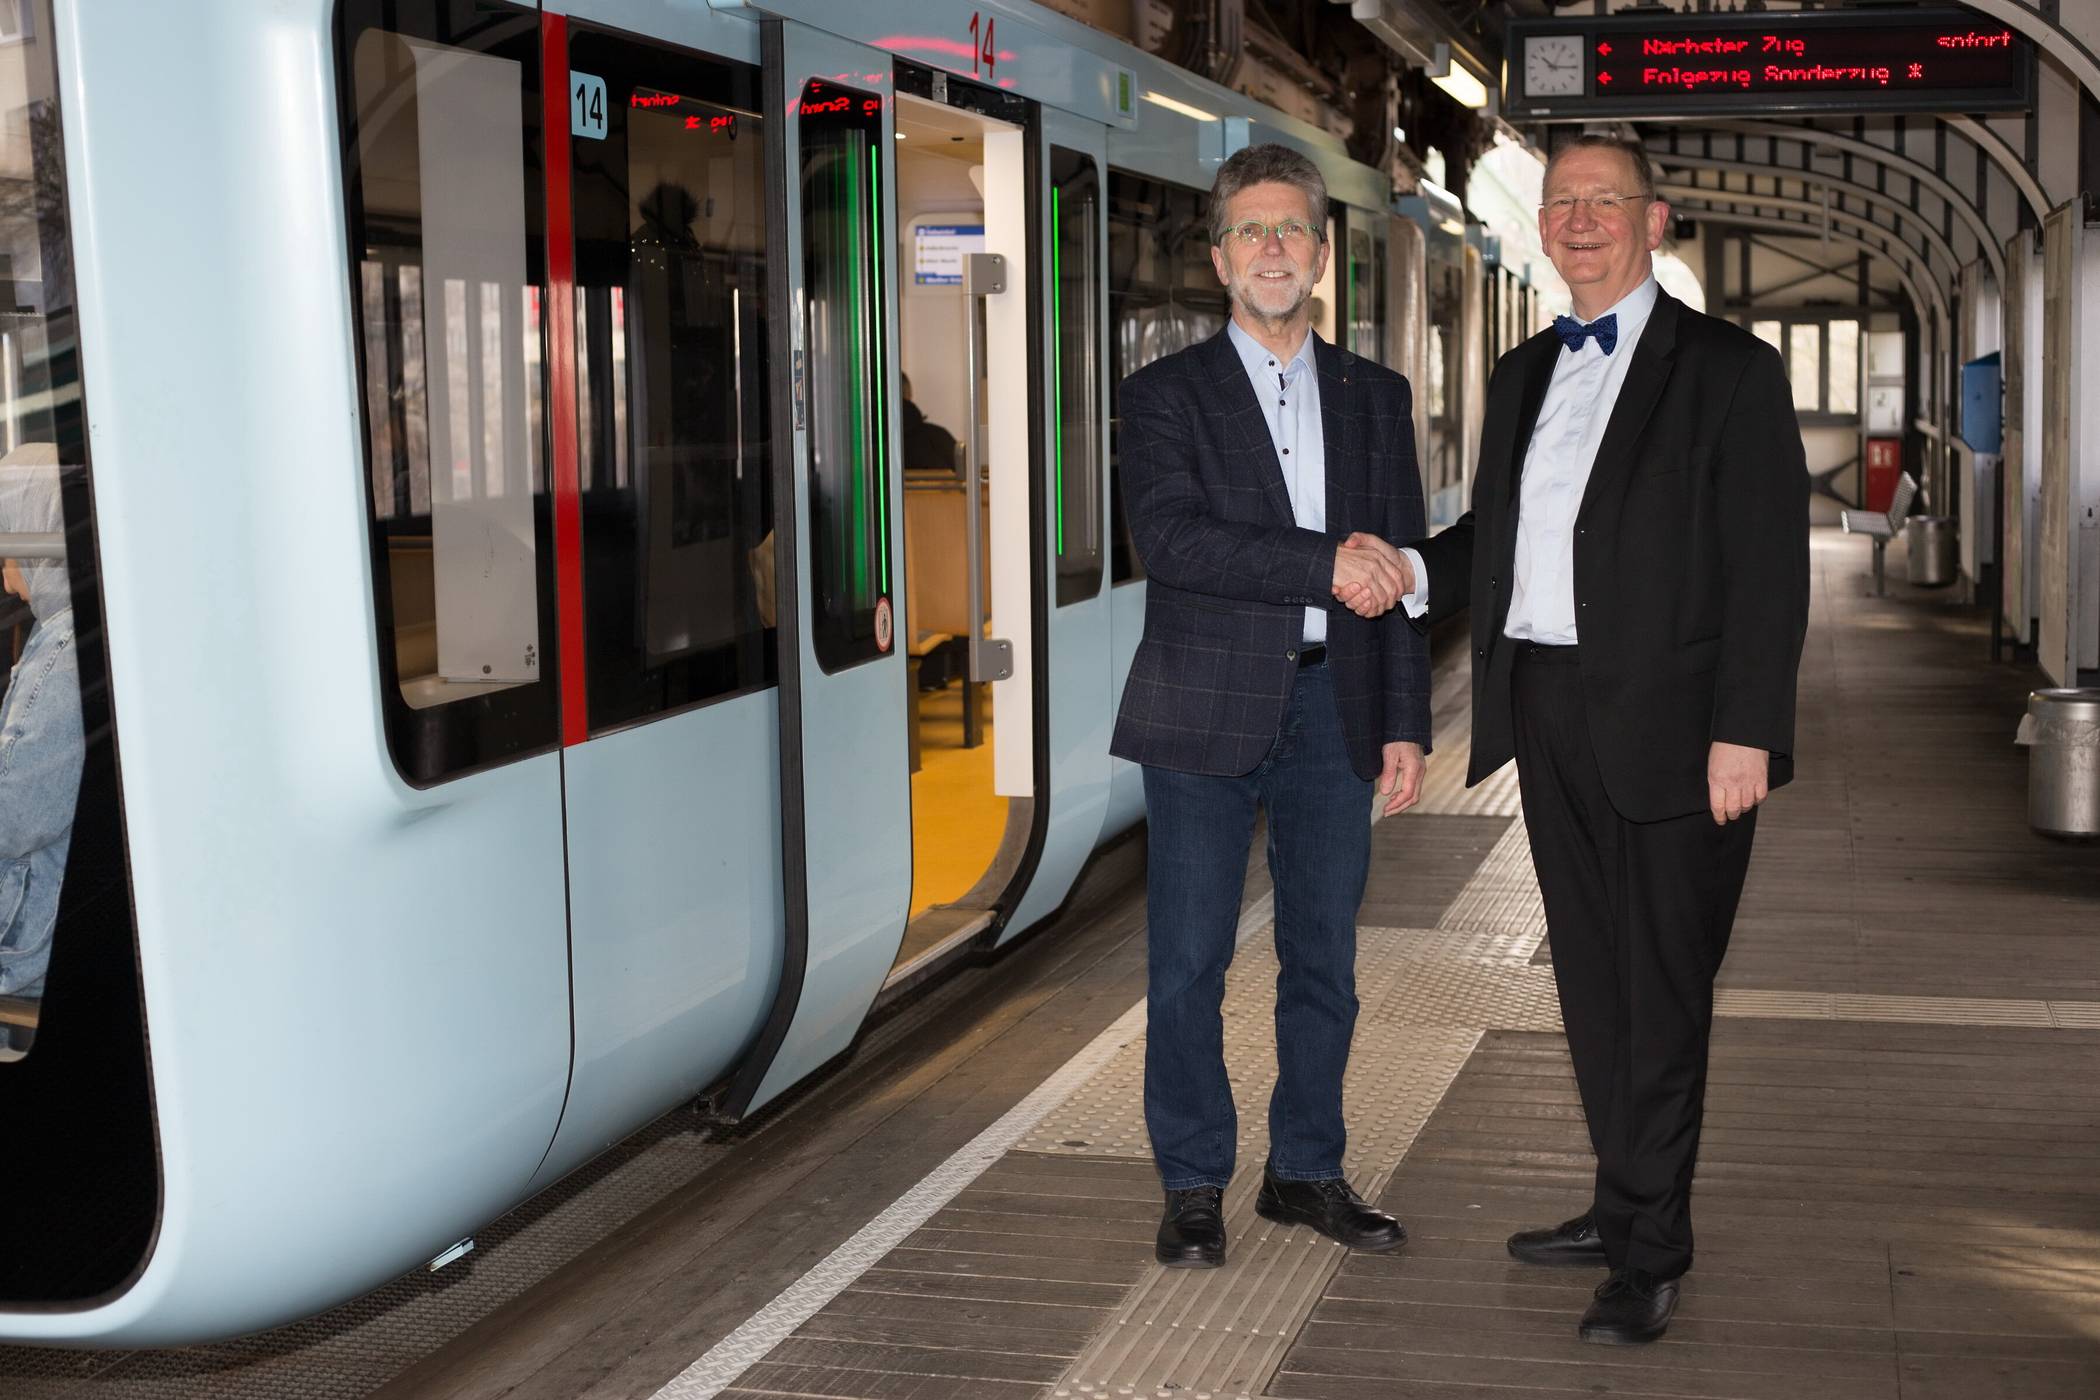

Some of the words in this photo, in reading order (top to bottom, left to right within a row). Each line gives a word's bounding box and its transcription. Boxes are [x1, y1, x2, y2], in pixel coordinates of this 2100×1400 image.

[969, 10, 995, 80] 14
[1761, 35, 1806, 58] Zug
[576, 83, 603, 130] 14
